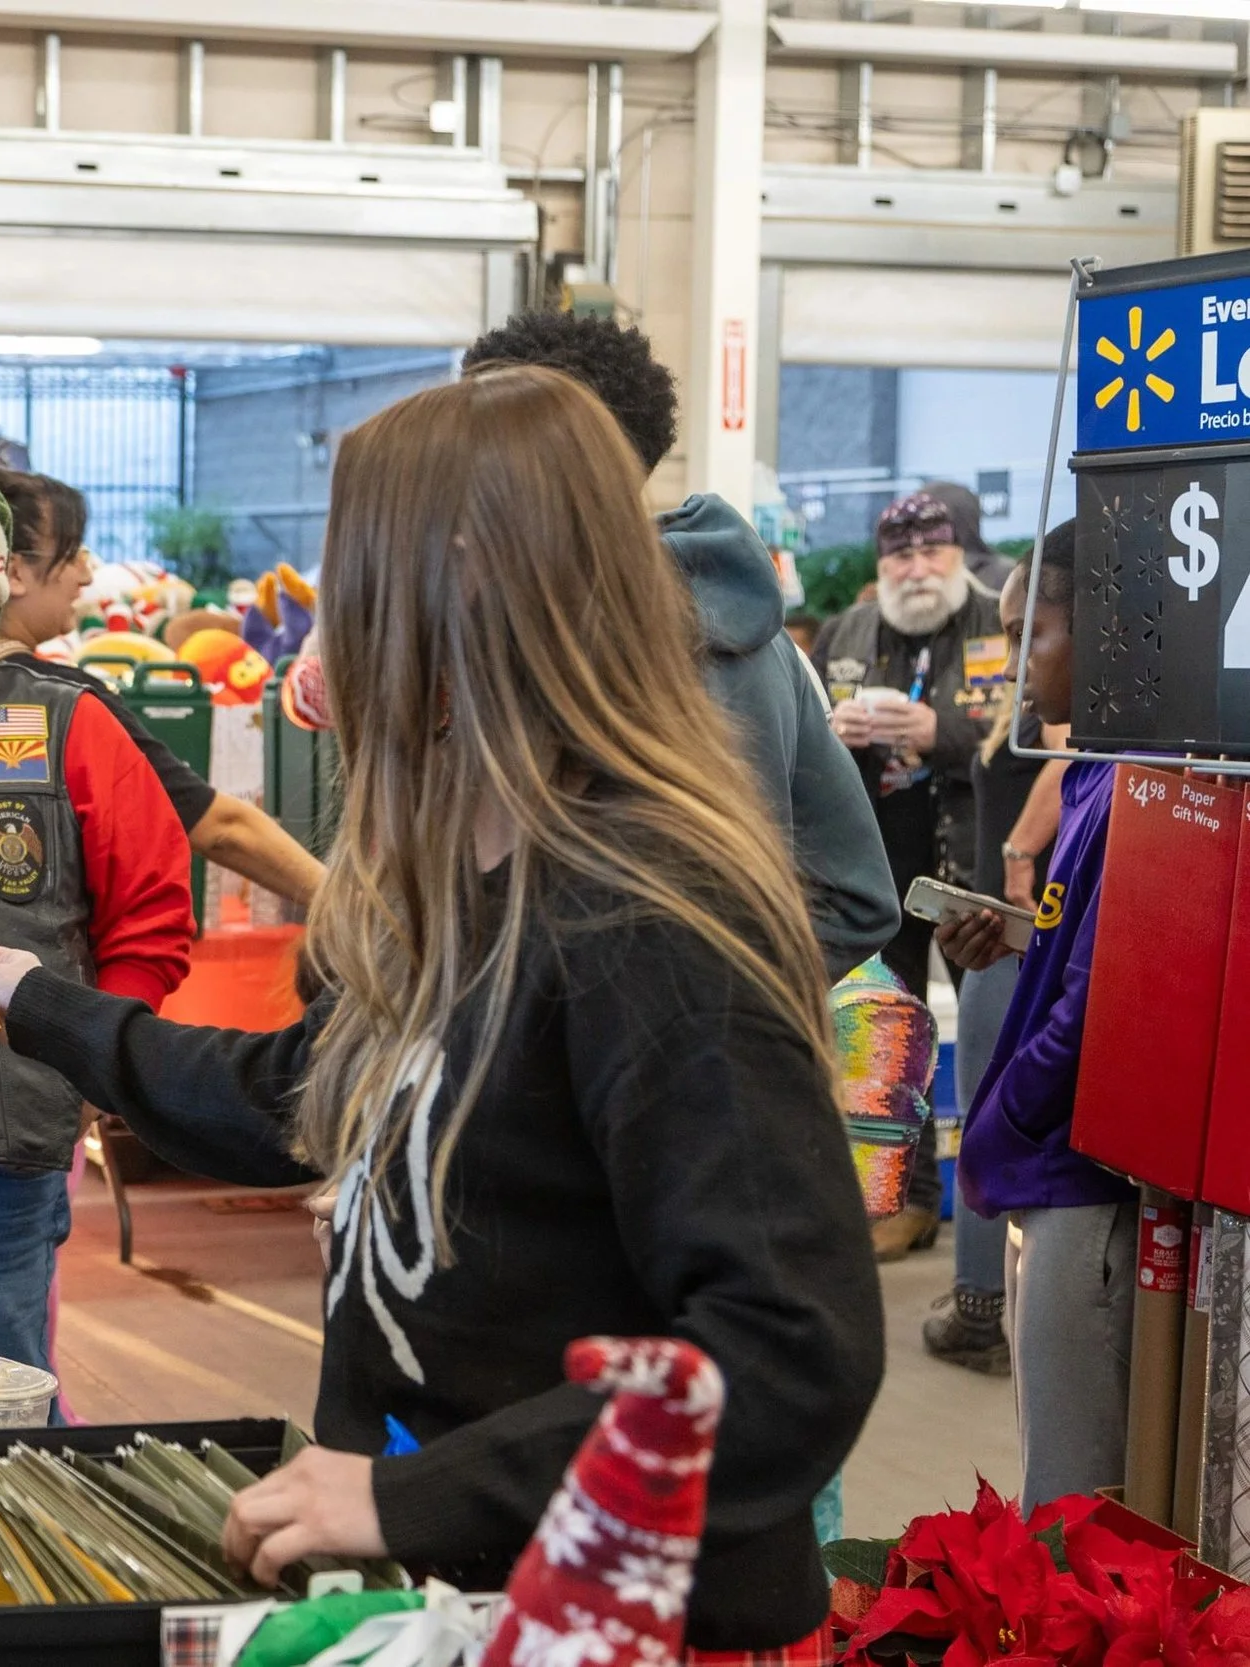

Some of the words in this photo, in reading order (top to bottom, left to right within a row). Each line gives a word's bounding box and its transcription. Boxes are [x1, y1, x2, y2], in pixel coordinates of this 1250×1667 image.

[1202, 296, 1250, 325] Eve
[1199, 410, 1240, 430] Precio
[1182, 783, 1216, 807] Paper
[1172, 804, 1192, 822] Gift
[1194, 810, 1220, 832] Wrap
